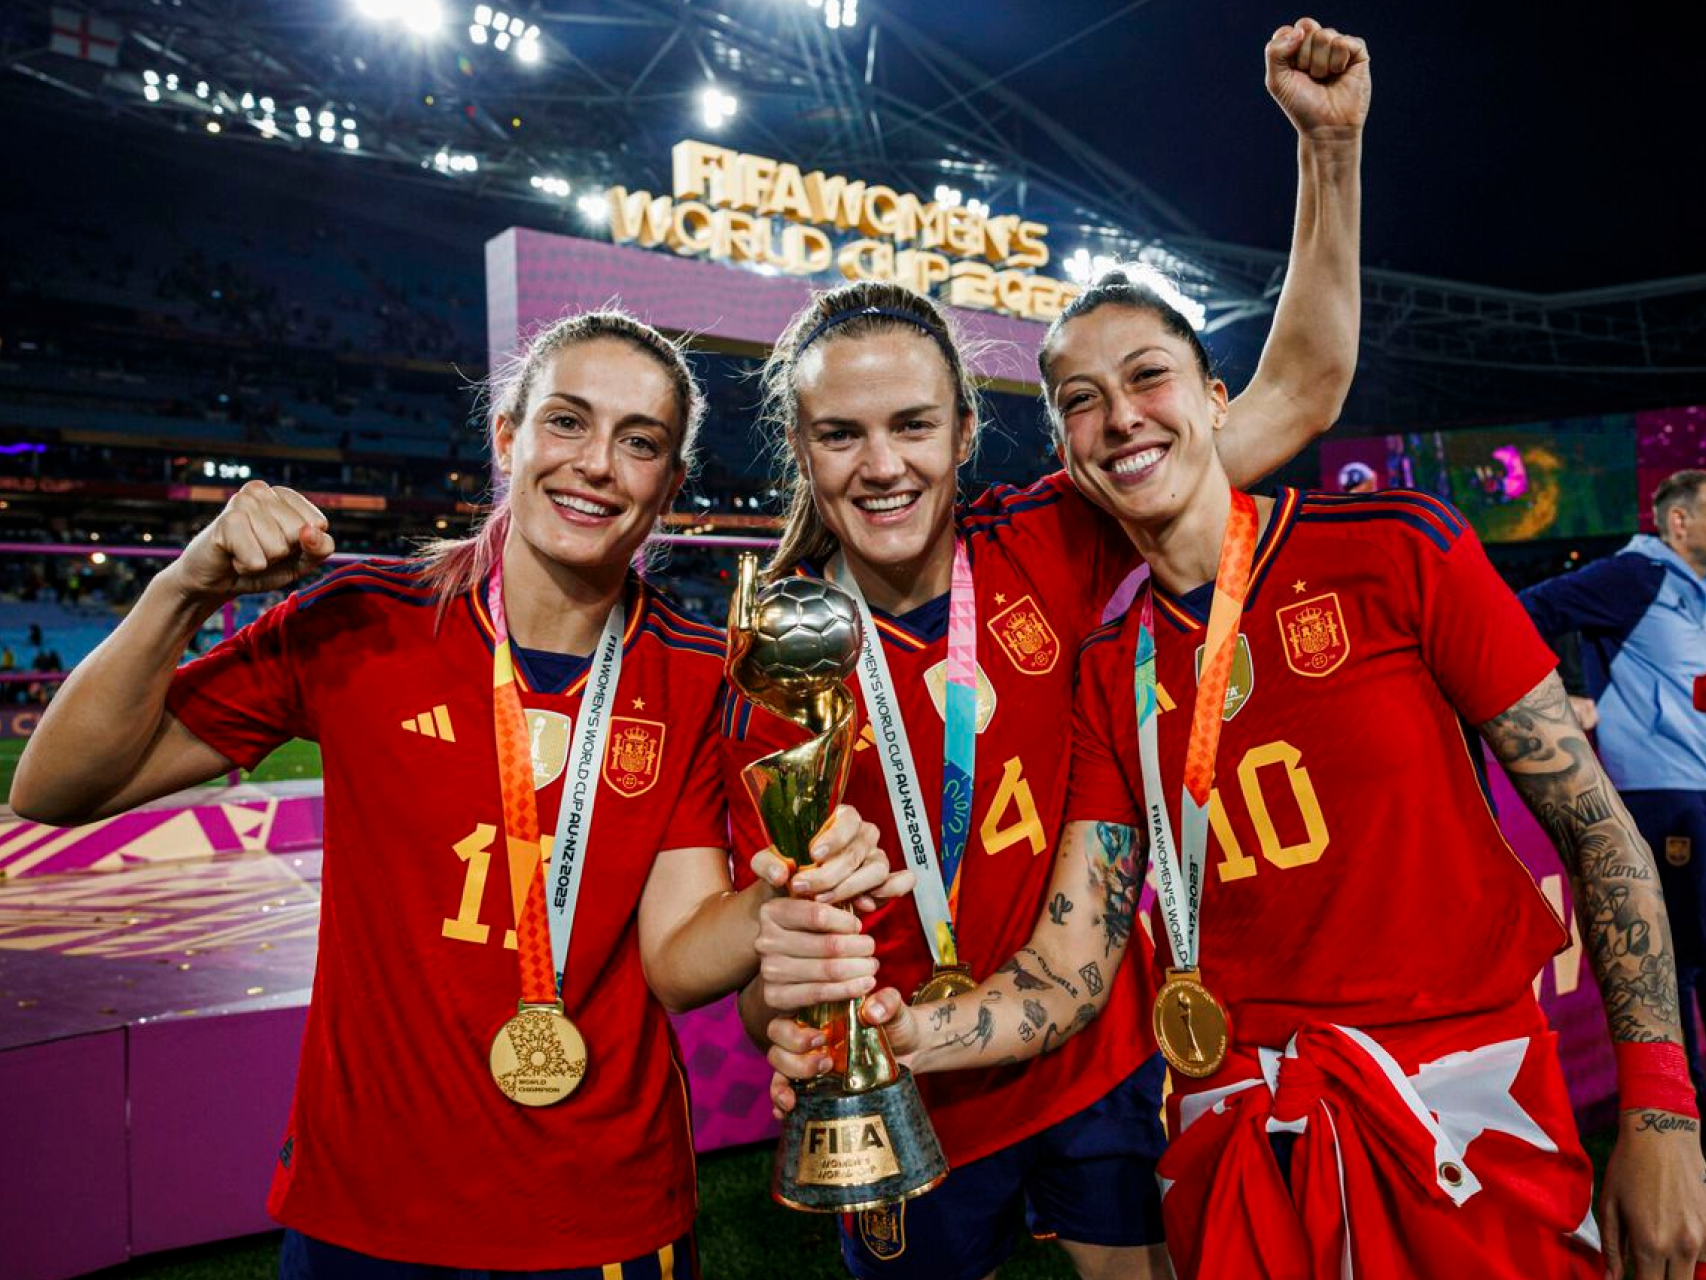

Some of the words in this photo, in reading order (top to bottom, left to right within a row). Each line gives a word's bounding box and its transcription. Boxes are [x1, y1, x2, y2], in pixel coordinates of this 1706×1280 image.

[672, 139, 813, 219] FIFA
[609, 185, 833, 275] WORLD
[838, 239, 950, 294] CUP
[603, 634, 618, 662] FIFA
[588, 664, 612, 727] WOMEN'S
[577, 729, 598, 780] WORLD
[874, 692, 896, 743] WORLD
[888, 743, 905, 771] CUP
[573, 781, 587, 812] CUP
[980, 755, 1047, 856] 4
[1151, 804, 1163, 837] FIFA
[1208, 740, 1330, 883] 10
[1156, 836, 1176, 907] WOMEN'S
[1167, 907, 1188, 963] WORLD
[808, 1123, 884, 1155] FIFA
